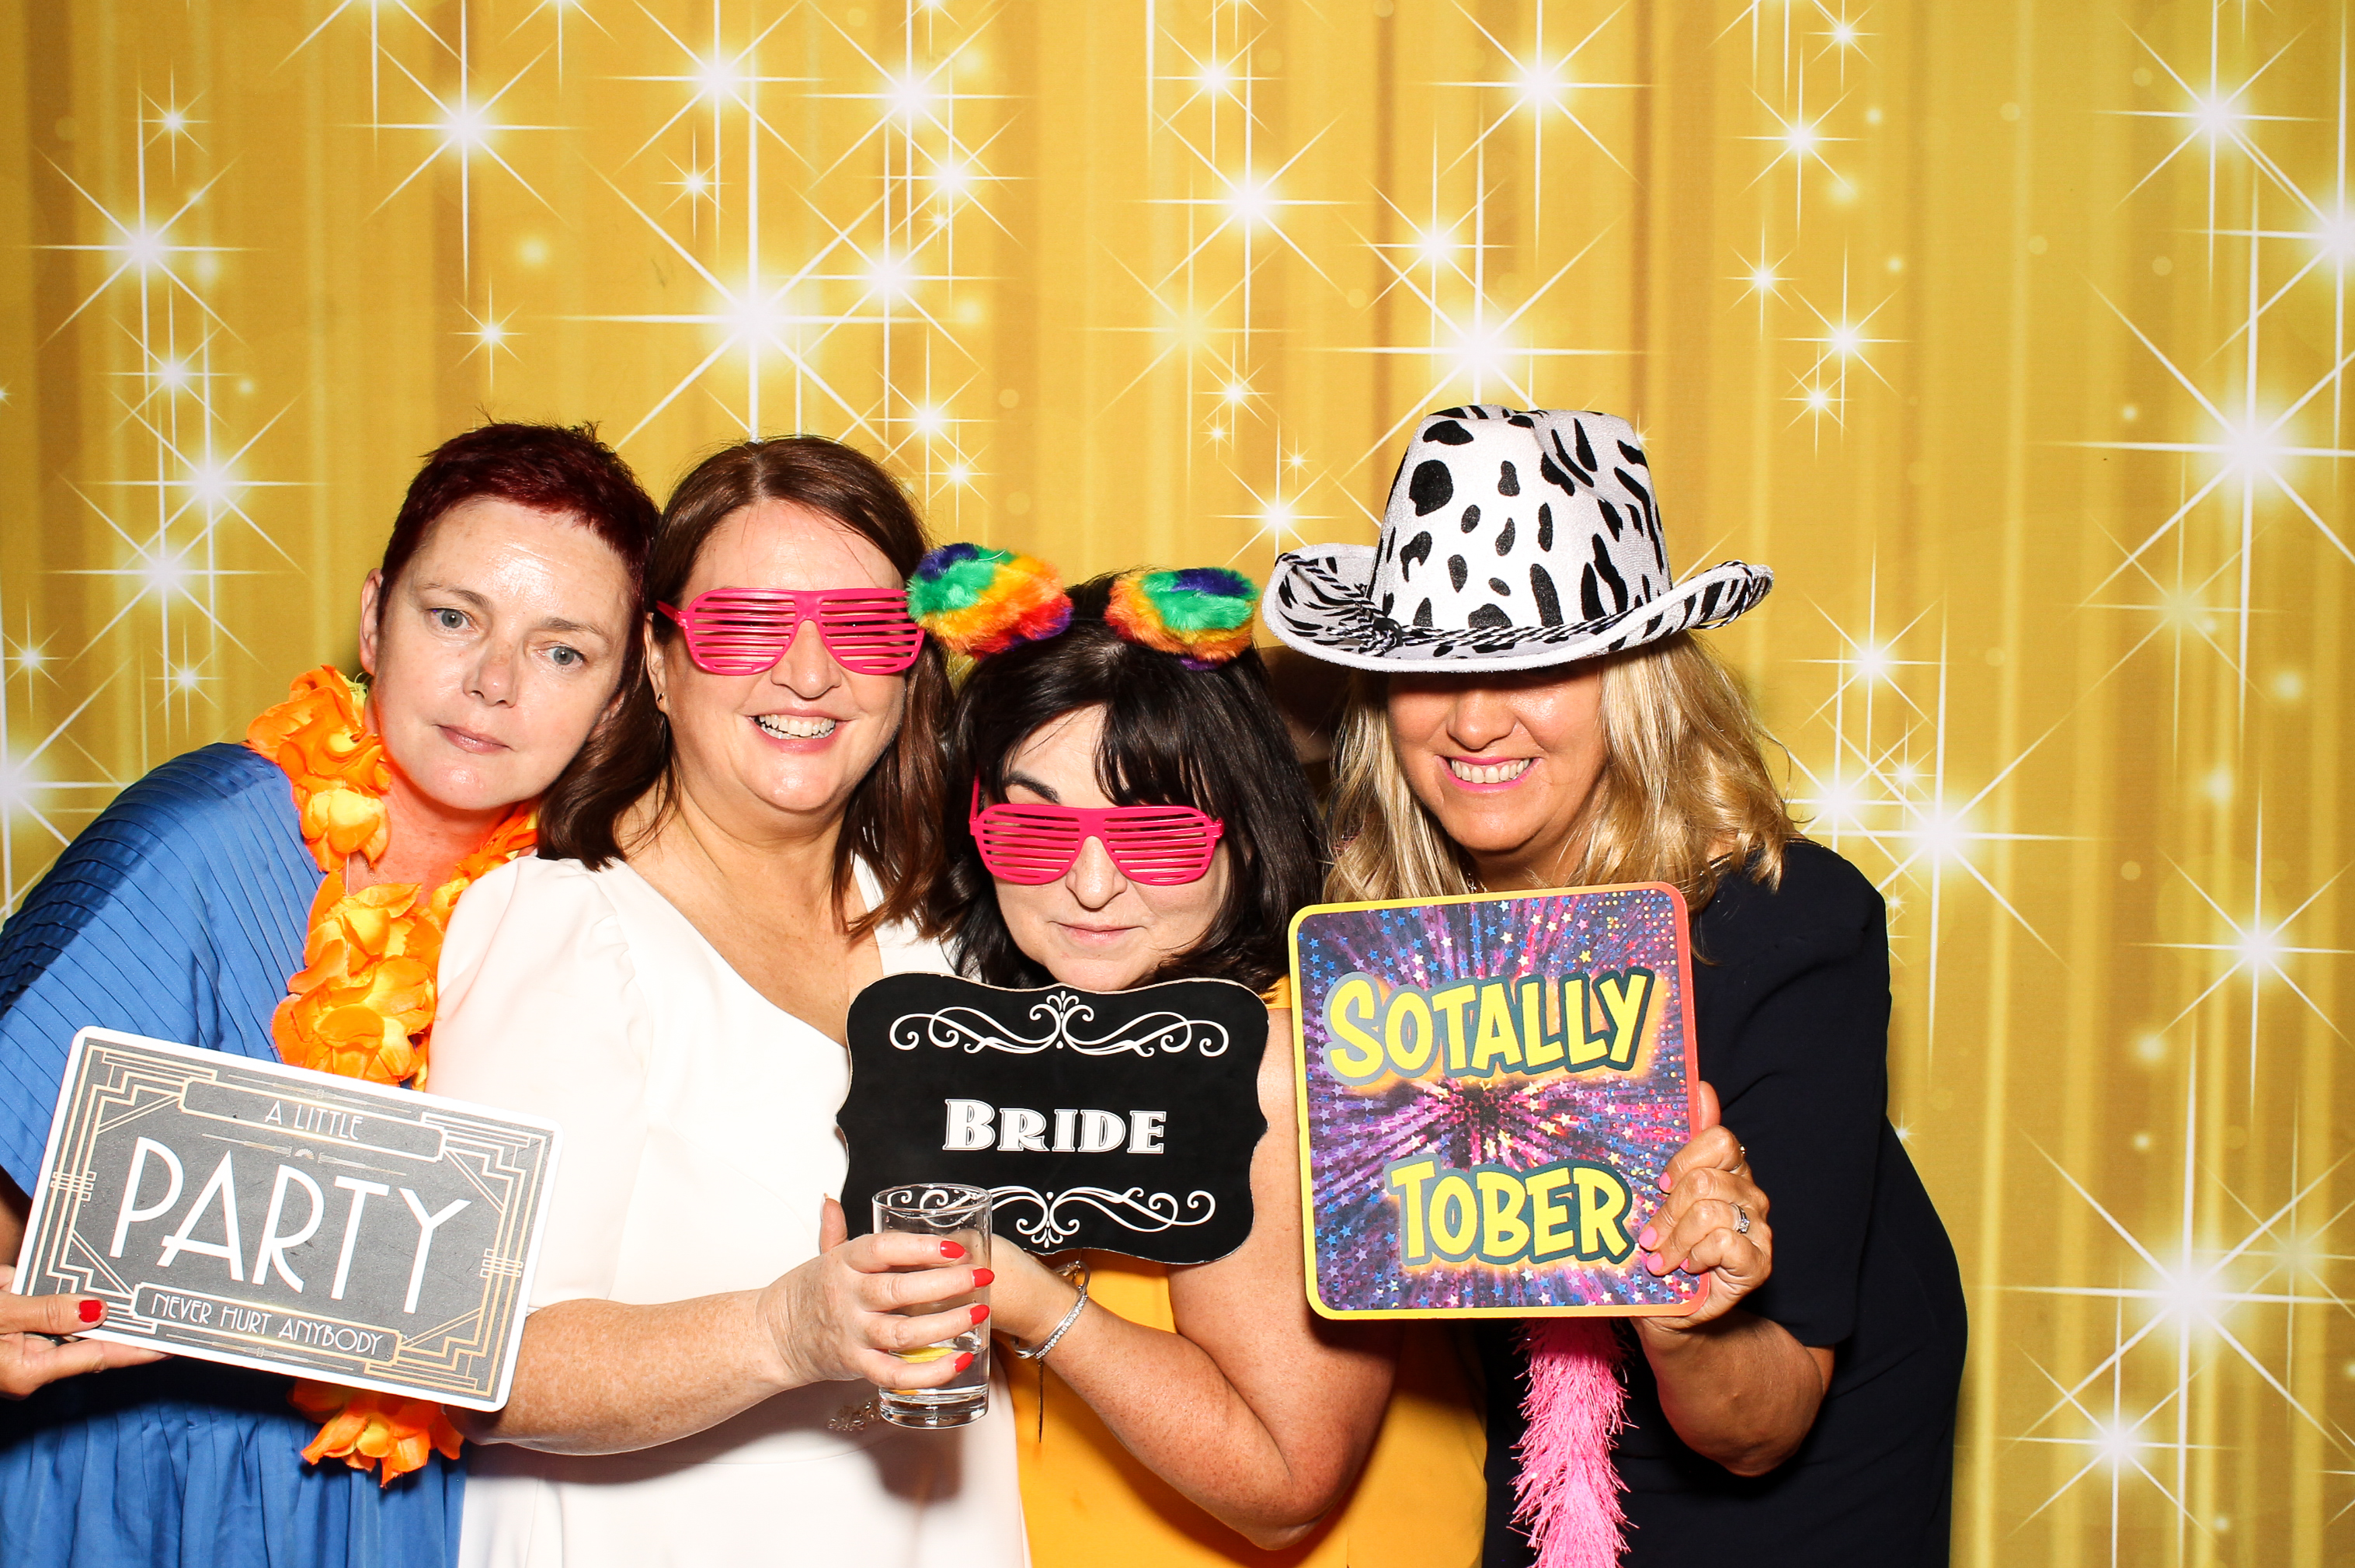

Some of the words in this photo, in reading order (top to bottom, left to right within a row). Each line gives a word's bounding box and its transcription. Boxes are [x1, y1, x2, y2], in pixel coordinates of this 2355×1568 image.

[1327, 972, 1649, 1080] SOTALLY
[265, 1100, 284, 1124] A
[294, 1104, 364, 1141] LITTLE
[942, 1098, 1167, 1154] BRIDE
[110, 1136, 471, 1314] PARTY
[1390, 1165, 1630, 1260] TOBER
[151, 1294, 213, 1325] NEVER
[220, 1307, 273, 1337] HURT
[278, 1319, 383, 1356] ANYBODY
